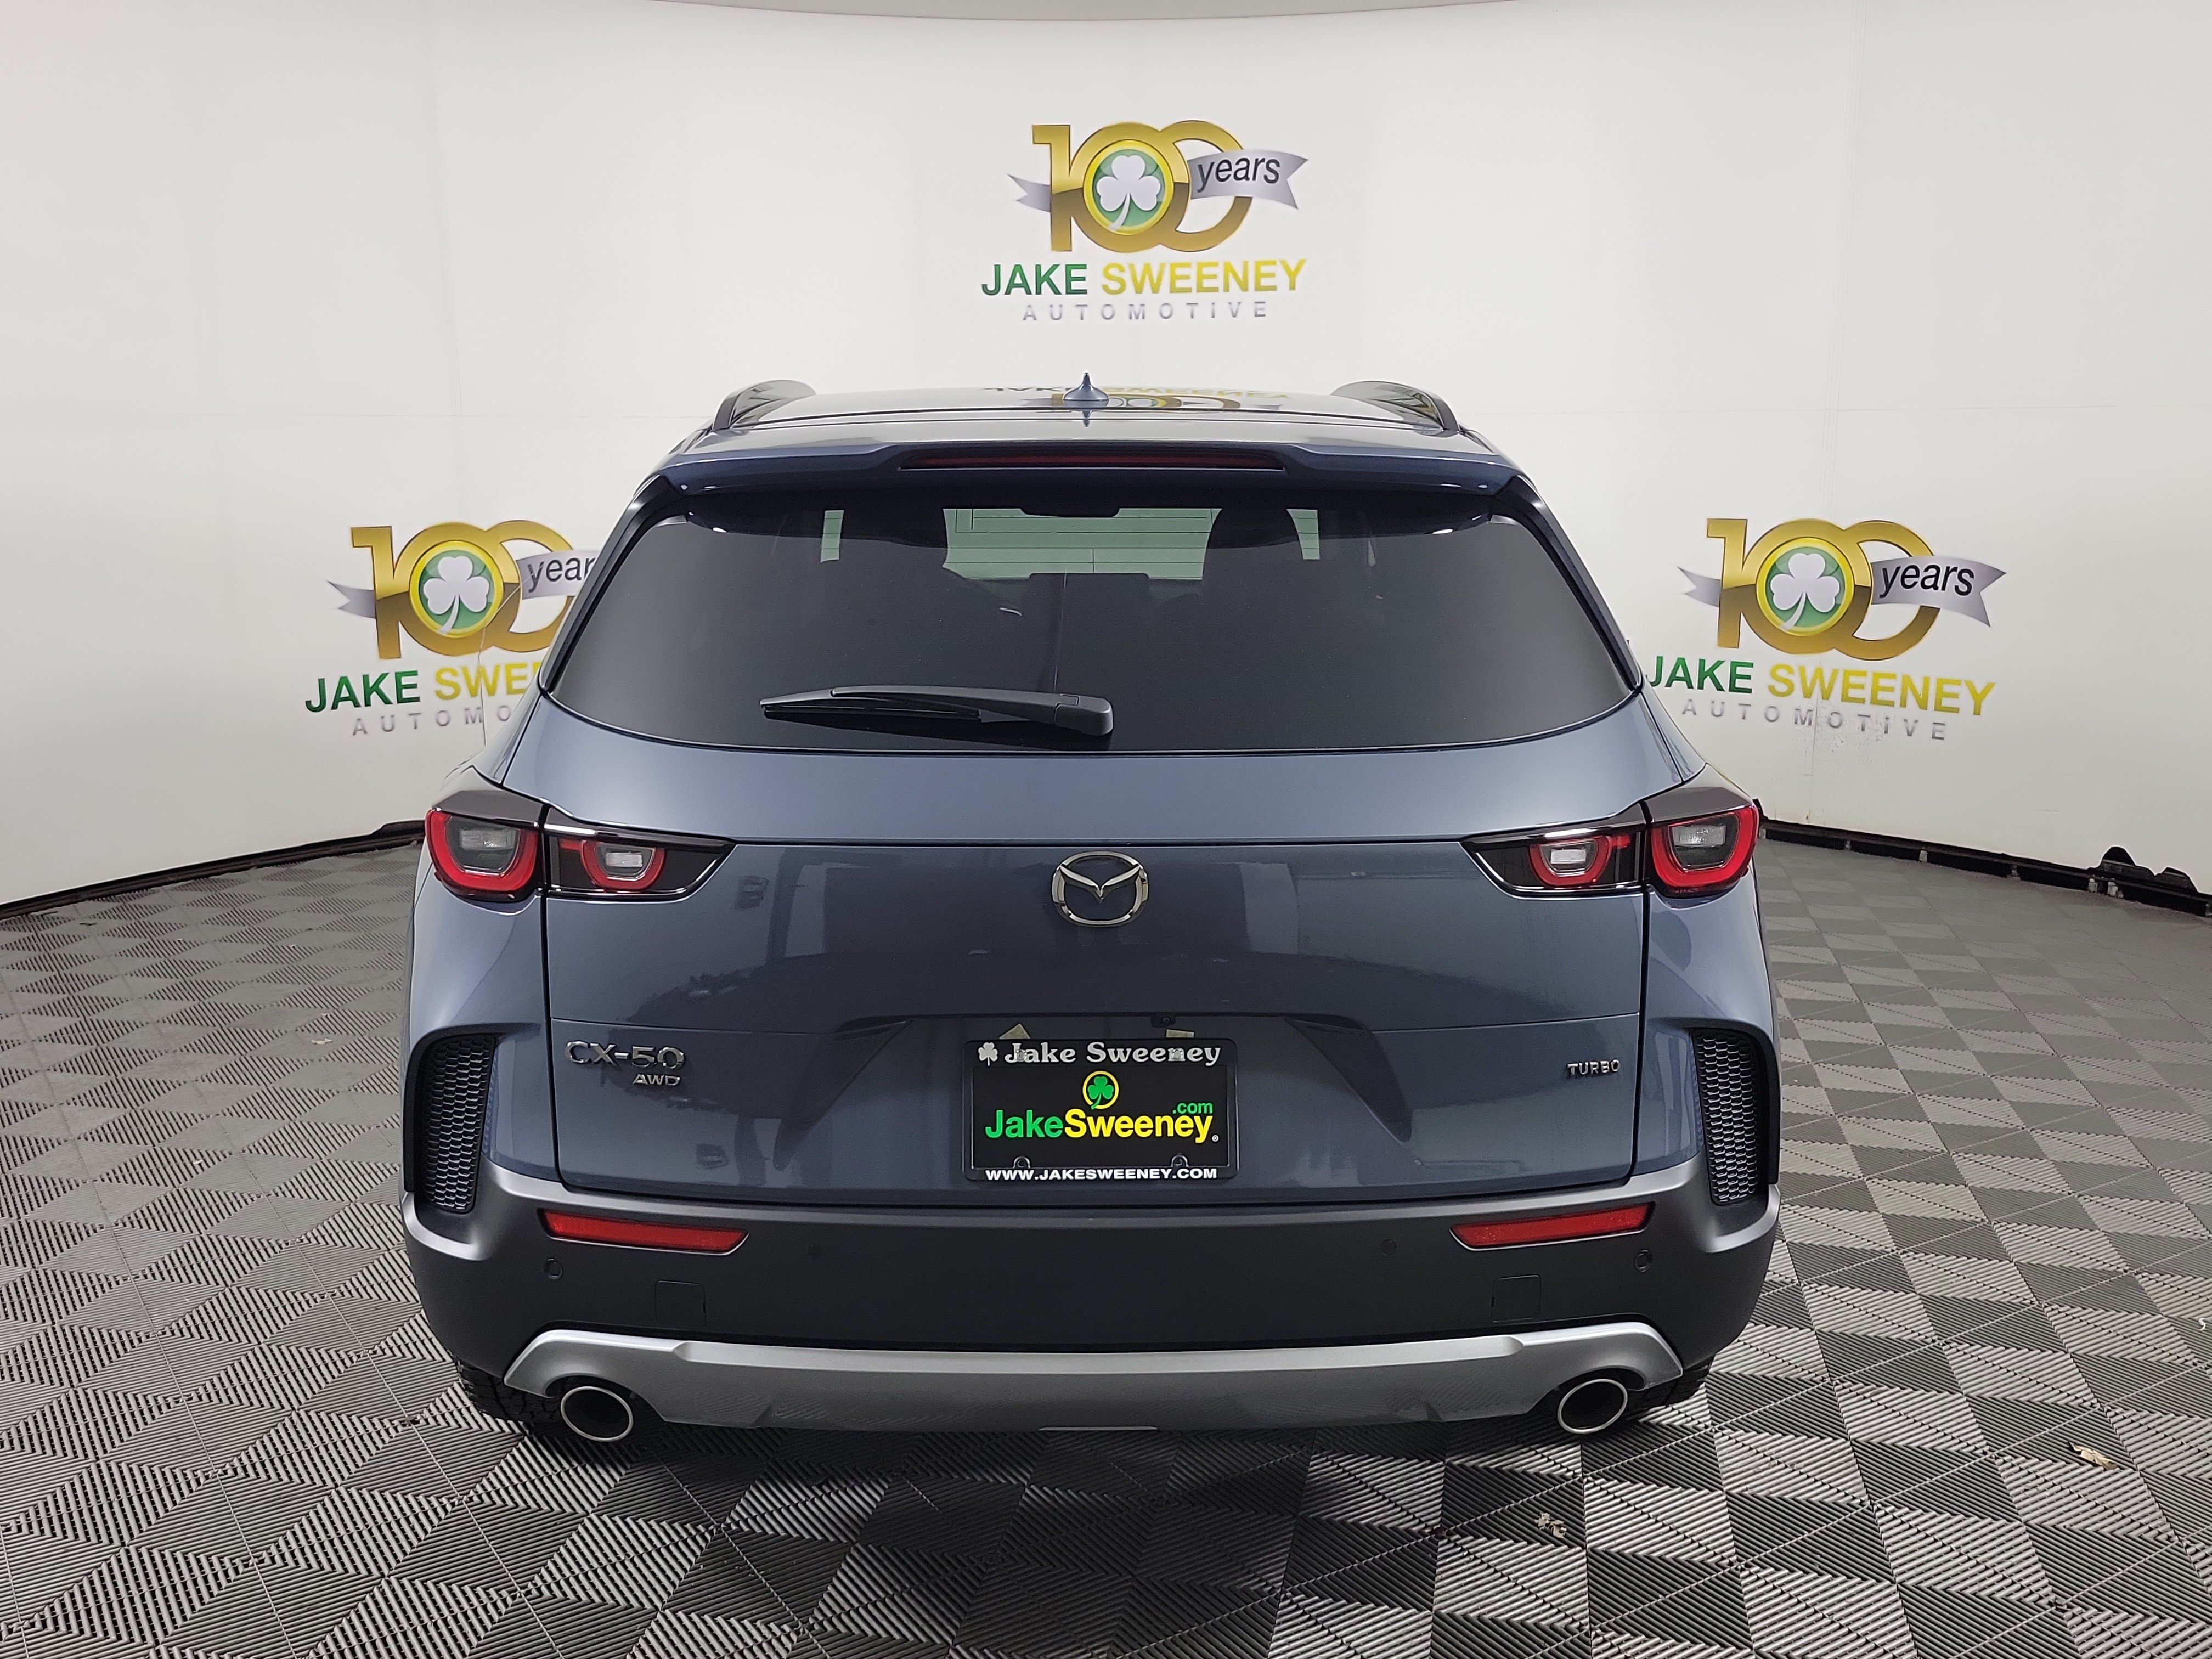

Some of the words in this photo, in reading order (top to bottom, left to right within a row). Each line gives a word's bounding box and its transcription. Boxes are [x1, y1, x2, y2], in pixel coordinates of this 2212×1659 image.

[1032, 120, 1252, 253] 100
[1197, 157, 1281, 193] years
[981, 264, 1088, 296] JAKE
[1101, 259, 1306, 295] SWEENEY
[1022, 301, 1267, 321] AUTOMOTIVE
[527, 557, 595, 592] year
[1706, 518, 1940, 661] 100
[1878, 563, 1975, 599] years
[305, 670, 421, 713] JAKE
[435, 661, 541, 700] SWE
[1648, 656, 1754, 693] JAKE
[1767, 662, 1996, 716] SWEENEY
[352, 706, 511, 736] AUTOMO
[1681, 699, 1946, 741] AUTOMOTIVE
[565, 1041, 685, 1069] CX-50
[1004, 1042, 1076, 1063] Jake
[1086, 1042, 1221, 1066] Sweeney
[1567, 1059, 1621, 1076] TURBO
[633, 1073, 680, 1086] AWD
[985, 1169, 1217, 1181] WWW.JAKESWEENEY.COM
